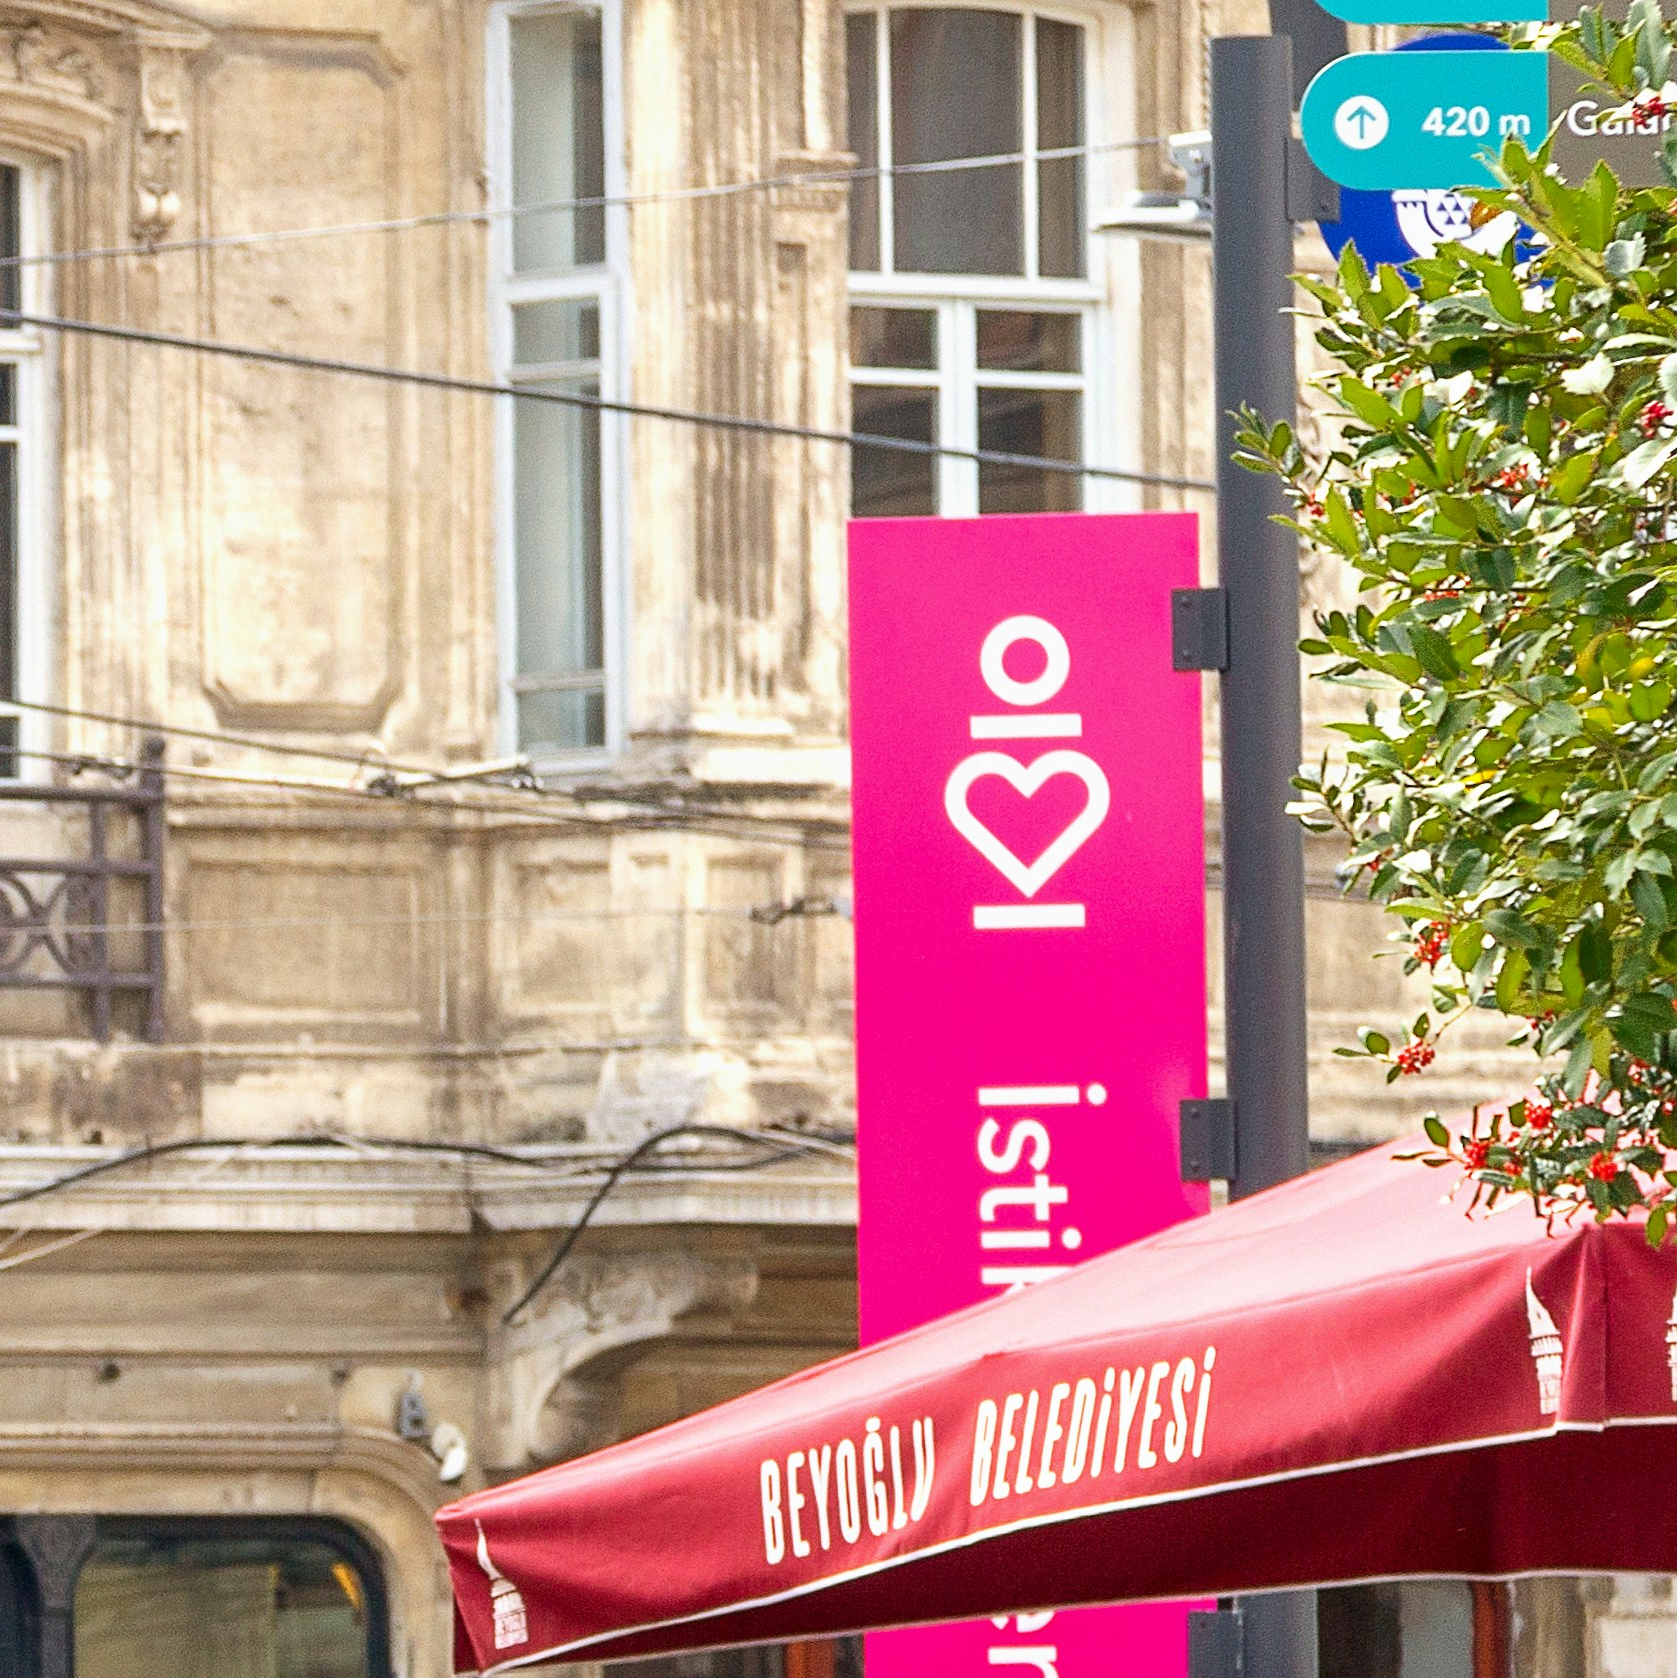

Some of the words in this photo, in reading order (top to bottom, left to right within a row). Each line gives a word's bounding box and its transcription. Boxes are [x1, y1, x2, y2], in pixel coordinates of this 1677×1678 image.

[1421, 105, 1490, 138] 420
[1498, 113, 1532, 137] m
[759, 1416, 936, 1566] BEYOĞLU
[969, 1346, 1217, 1507] BELEDİYESİ
